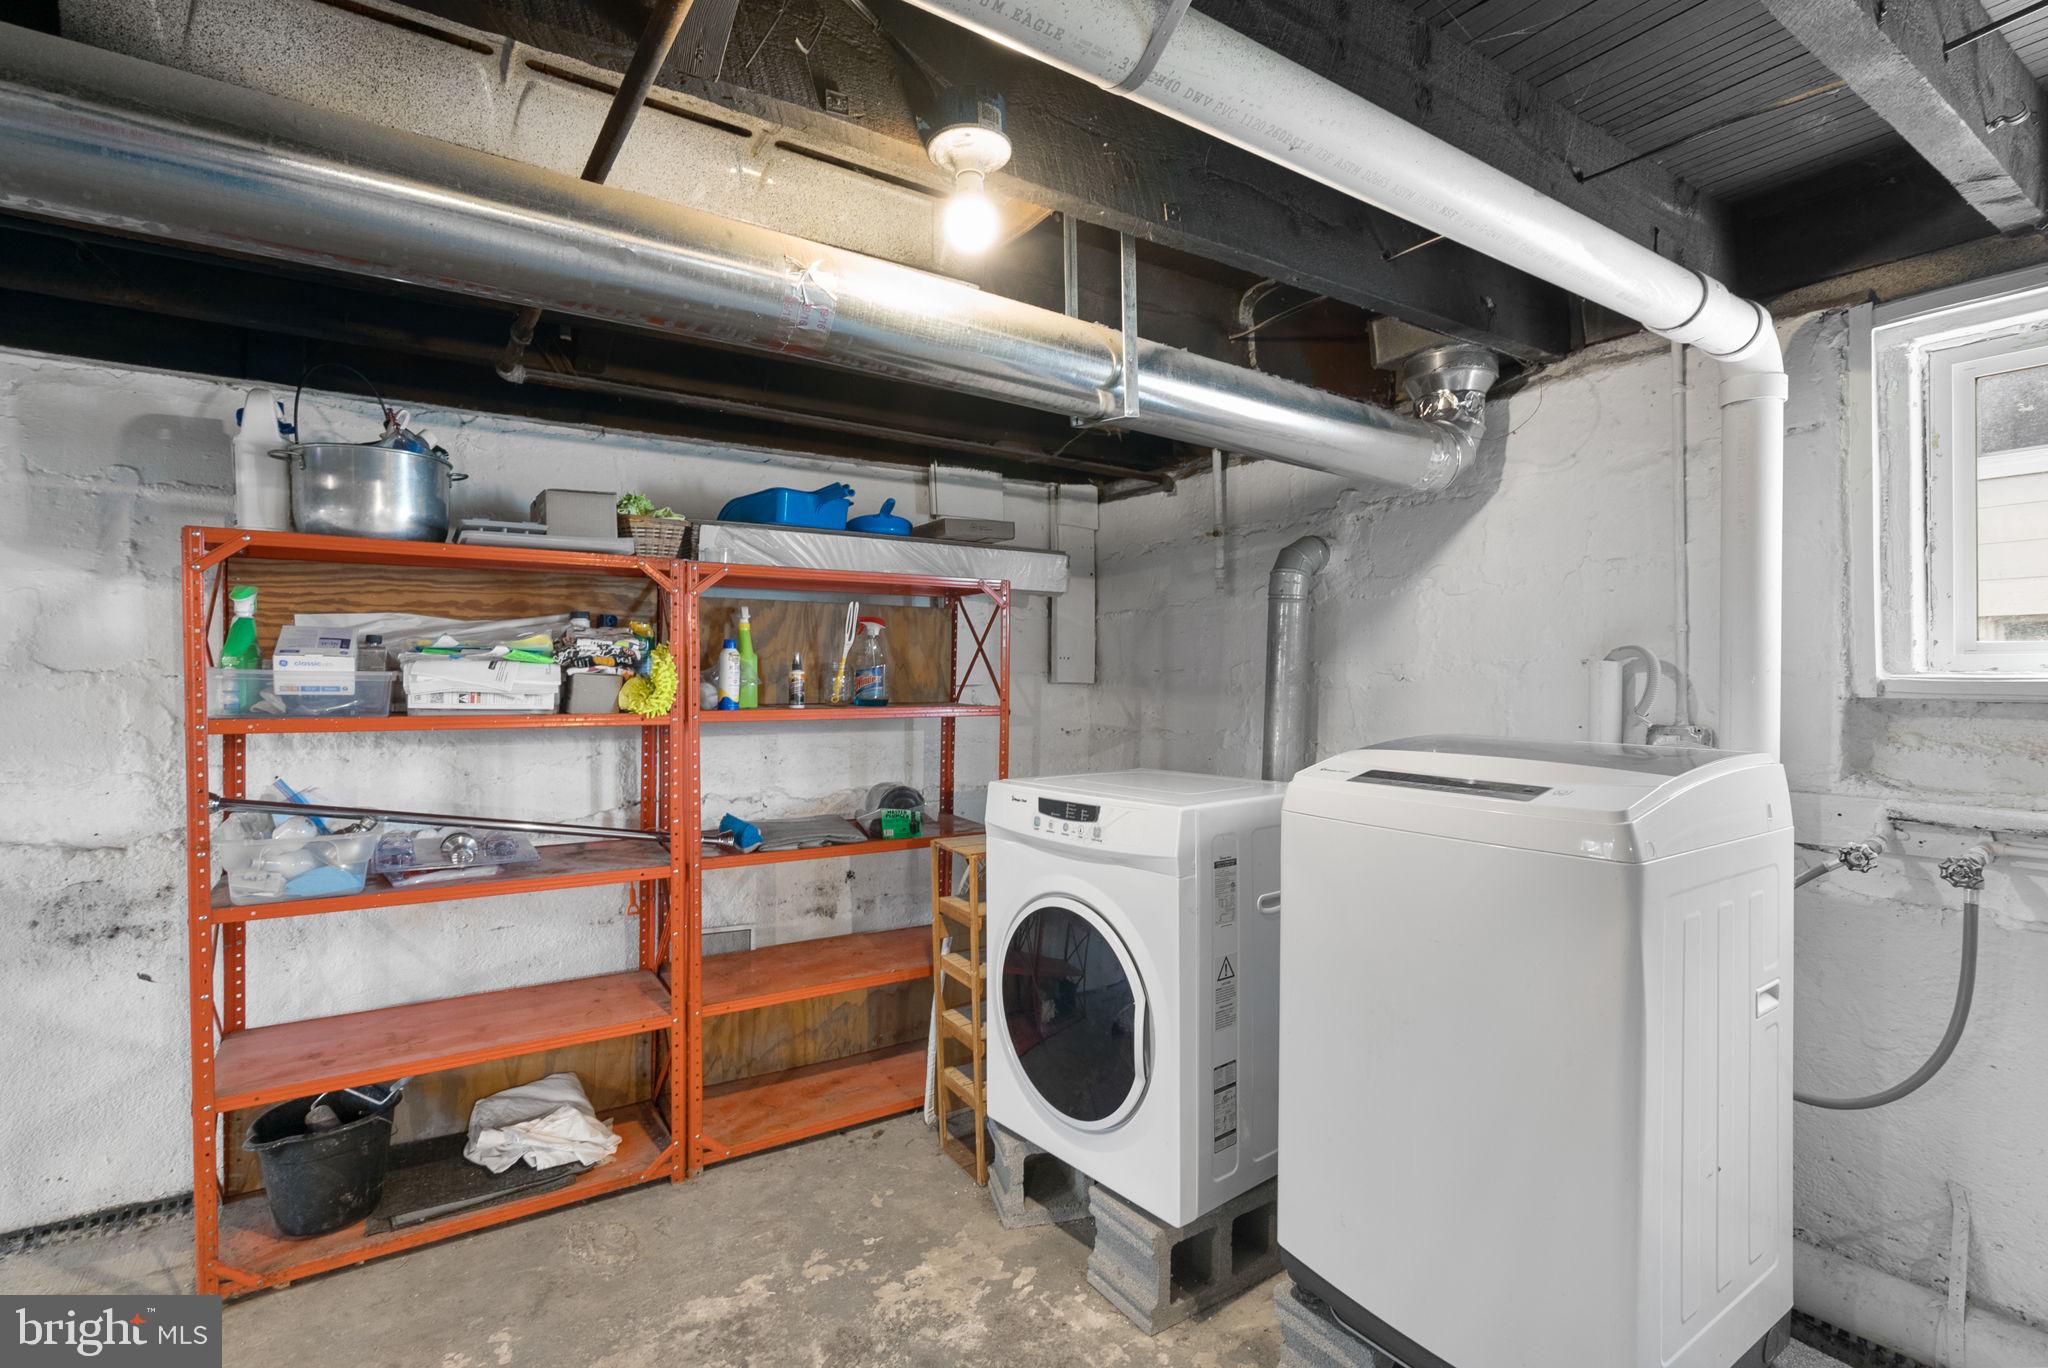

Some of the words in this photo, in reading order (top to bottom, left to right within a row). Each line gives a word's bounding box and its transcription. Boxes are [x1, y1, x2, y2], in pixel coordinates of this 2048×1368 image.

[1010, 8, 1066, 41] EAGLE
[1182, 87, 1213, 107] DWV
[1212, 101, 1238, 120] PVC
[1239, 113, 1266, 132] 1120
